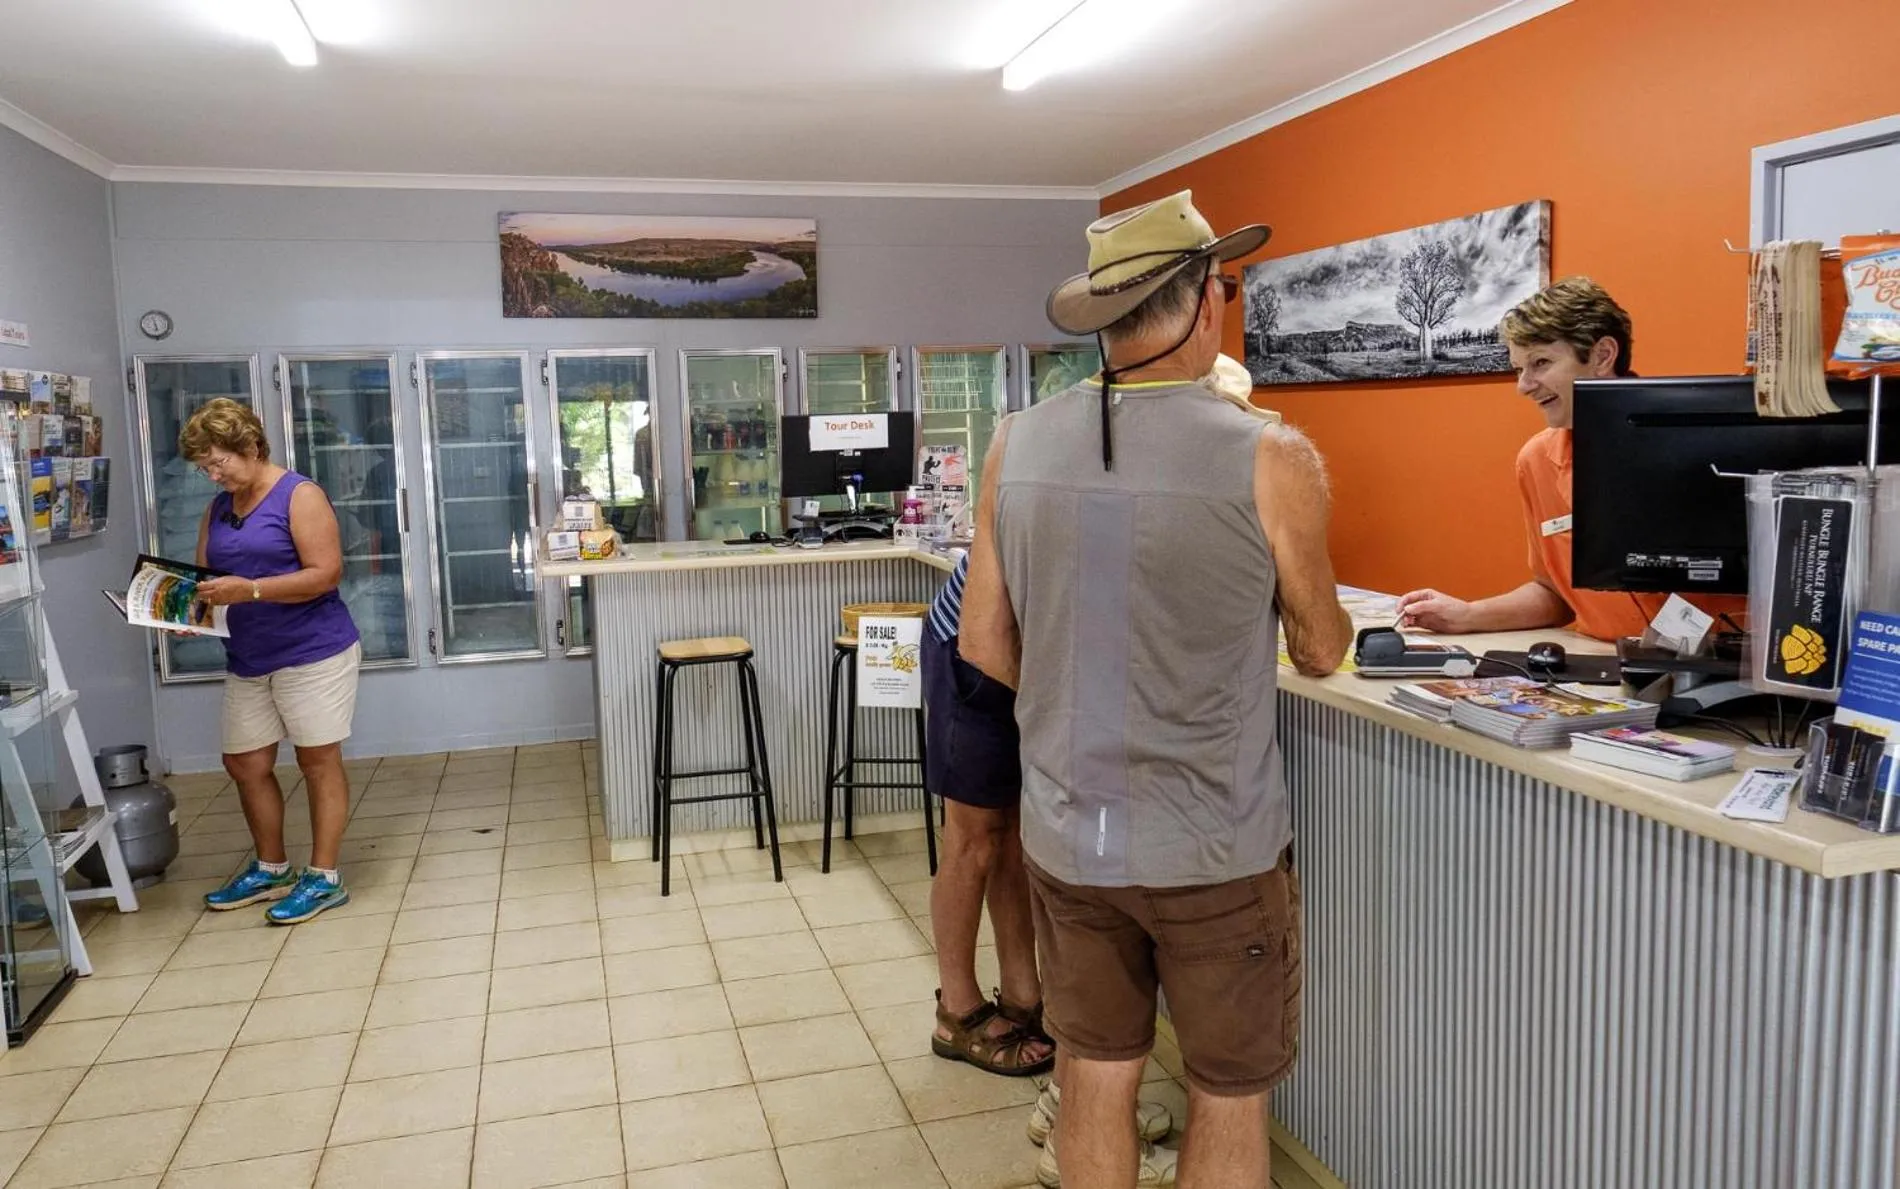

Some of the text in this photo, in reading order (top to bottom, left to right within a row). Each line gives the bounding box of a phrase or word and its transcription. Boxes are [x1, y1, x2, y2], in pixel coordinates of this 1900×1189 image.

[824, 420, 875, 431] Tour Desk
[1811, 508, 1834, 623] BUNGLE BUNGLE RANGE
[865, 625, 878, 639] FOR
[1860, 620, 1885, 633] NEED
[1857, 637, 1888, 652] SPARE
